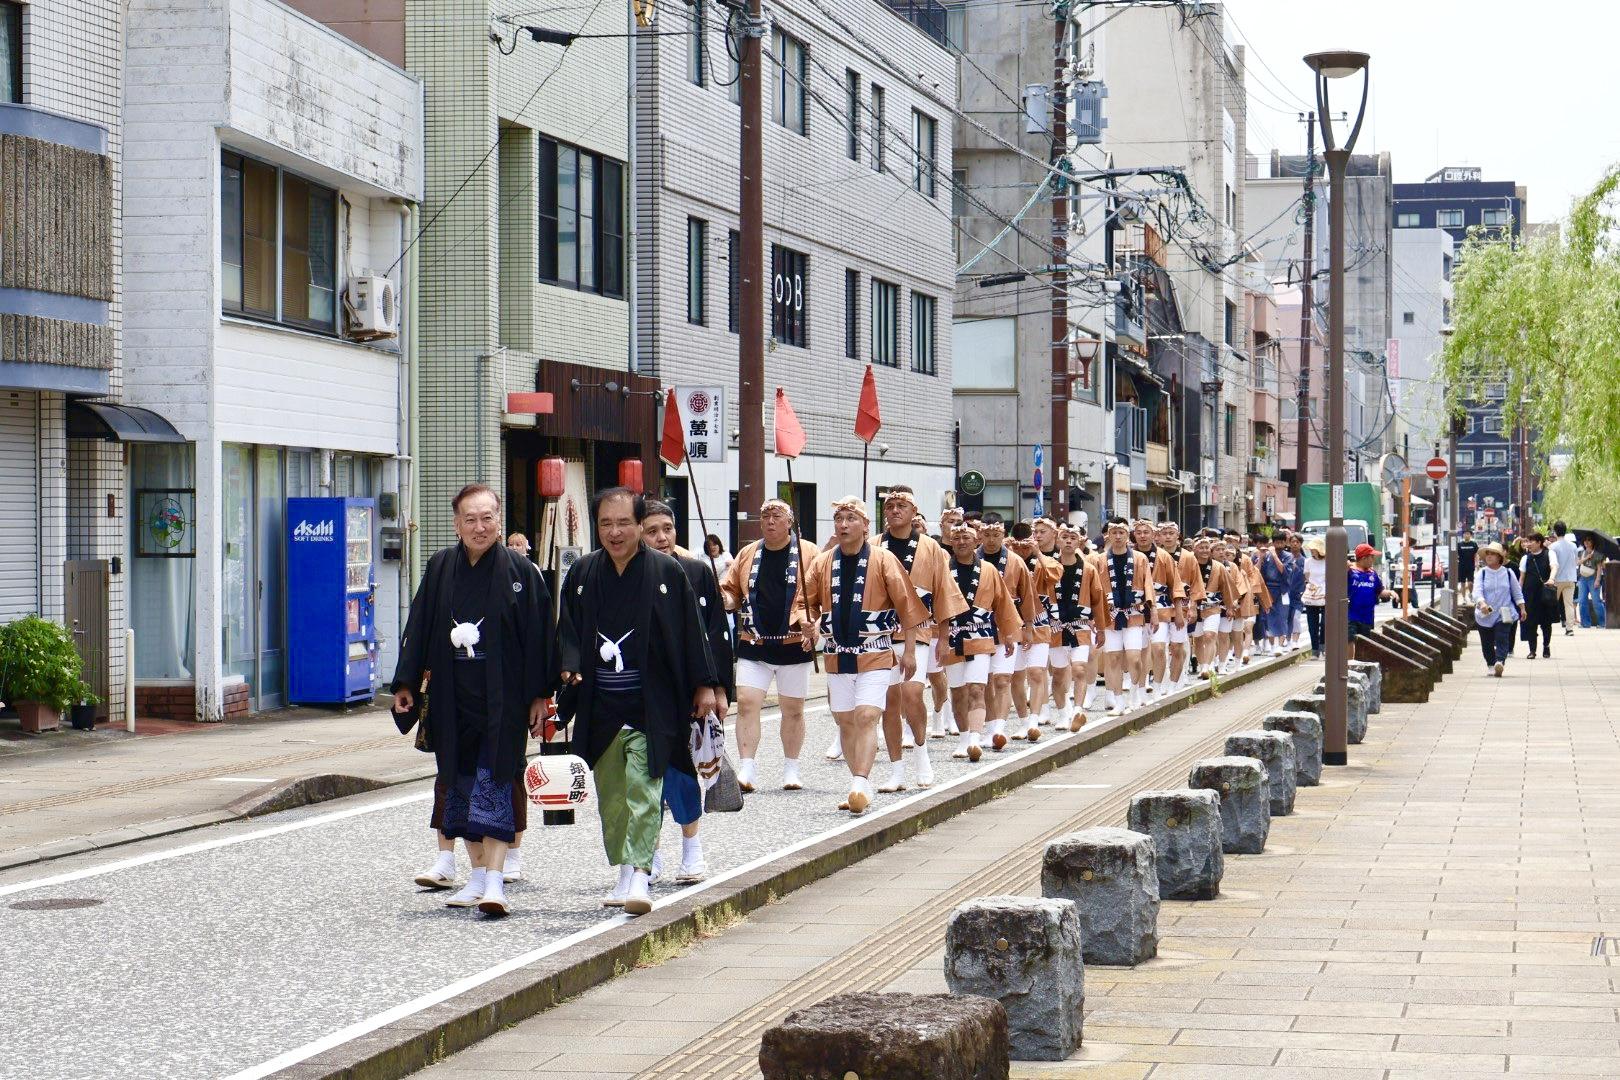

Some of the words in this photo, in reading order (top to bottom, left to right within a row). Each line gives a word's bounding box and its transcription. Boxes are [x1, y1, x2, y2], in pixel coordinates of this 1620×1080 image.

[689, 420, 708, 458] 萬順
[293, 519, 334, 536] Asahi
[569, 761, 586, 803] 銀屋町
